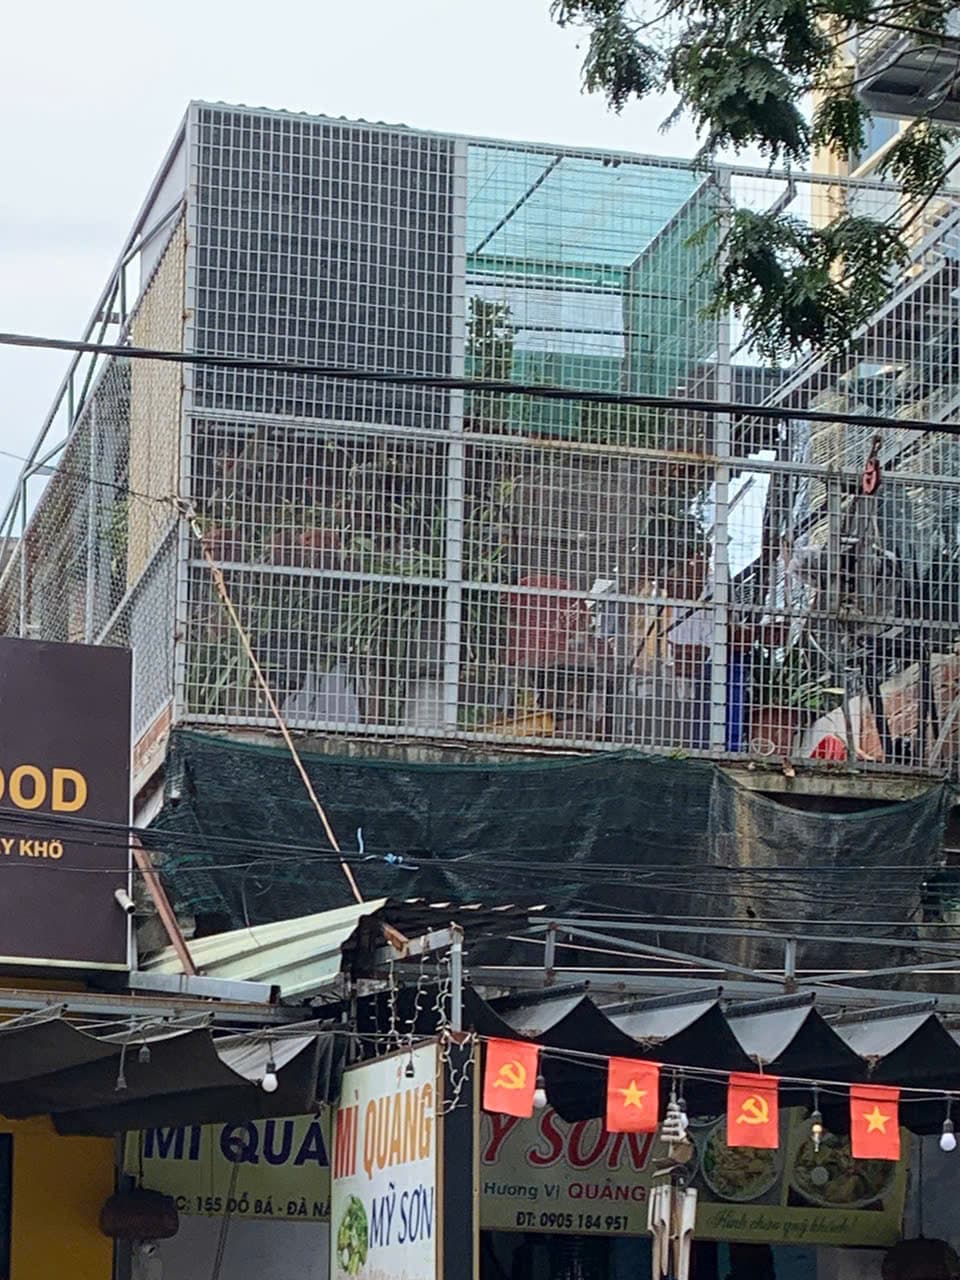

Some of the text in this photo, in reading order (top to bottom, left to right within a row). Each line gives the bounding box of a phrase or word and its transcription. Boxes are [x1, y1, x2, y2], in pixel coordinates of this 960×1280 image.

[333, 1089, 359, 1180] MÌ
[568, 1177, 647, 1201] QUẢNG
[197, 1196, 222, 1212] 155
[254, 1195, 274, 1215] BÁ
[287, 1197, 308, 1217] ĐÀ
[370, 1182, 434, 1249] MỲ SƠN
[516, 1211, 628, 1231] ĐT: 0905 184 951
